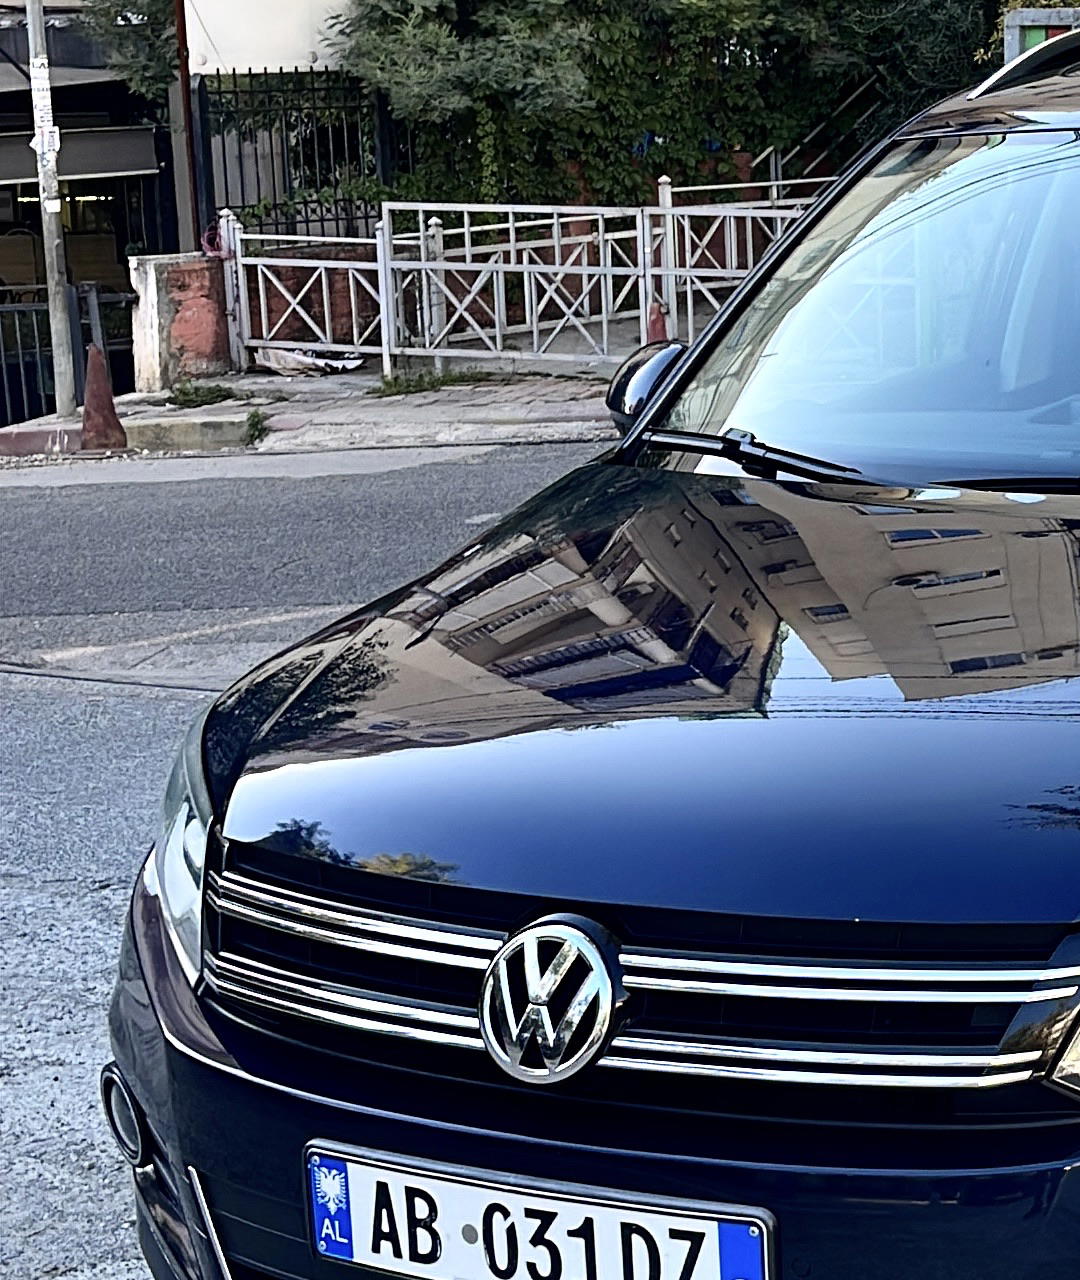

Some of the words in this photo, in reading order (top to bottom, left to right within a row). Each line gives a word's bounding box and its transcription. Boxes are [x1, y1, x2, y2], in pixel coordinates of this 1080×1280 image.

[482, 925, 612, 1083] VW
[321, 1222, 348, 1244] AL
[371, 1180, 442, 1265] AB
